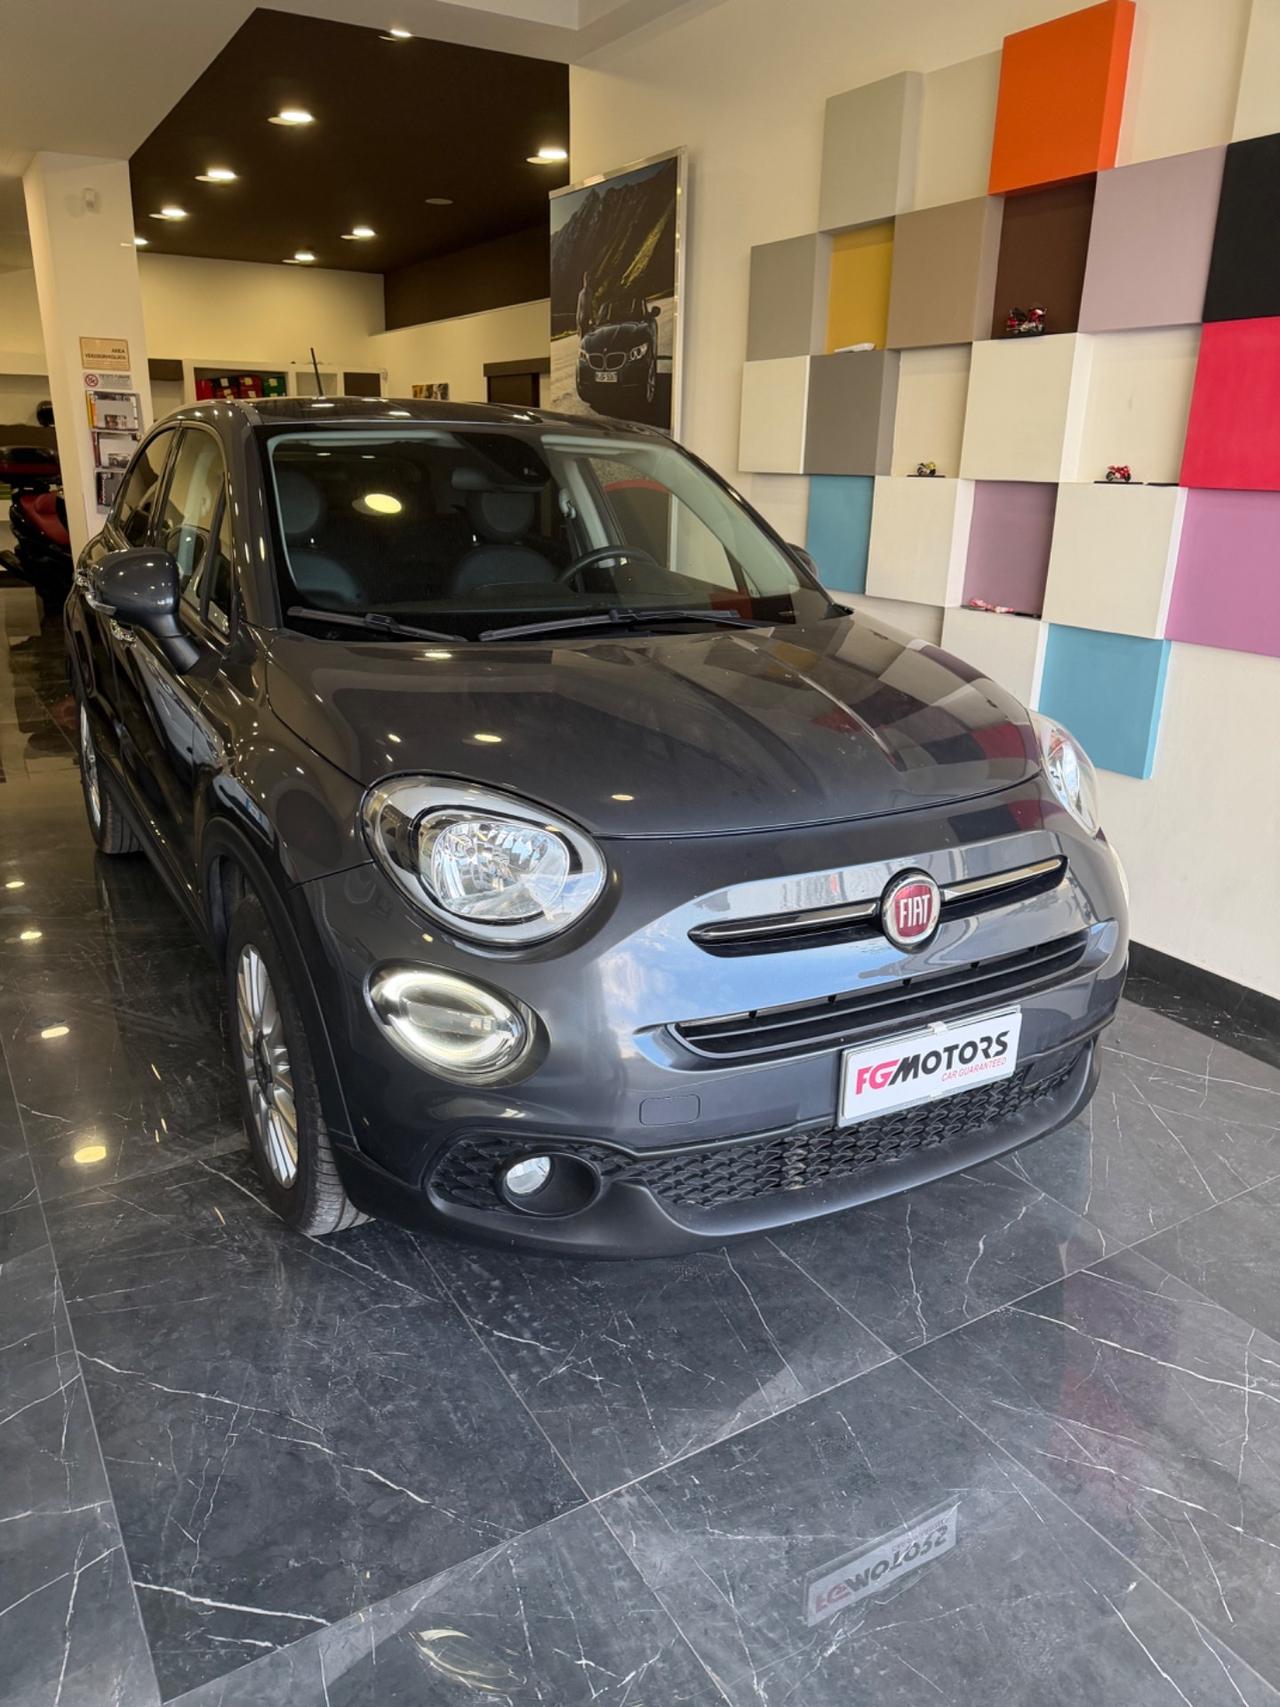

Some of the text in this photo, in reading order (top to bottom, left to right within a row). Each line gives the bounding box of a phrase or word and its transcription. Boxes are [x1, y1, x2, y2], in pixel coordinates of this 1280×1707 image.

[899, 894, 931, 929] FIAT
[855, 1030, 1010, 1095] FGMOTORS
[941, 1056, 1007, 1082] CAR GUARANTEED
